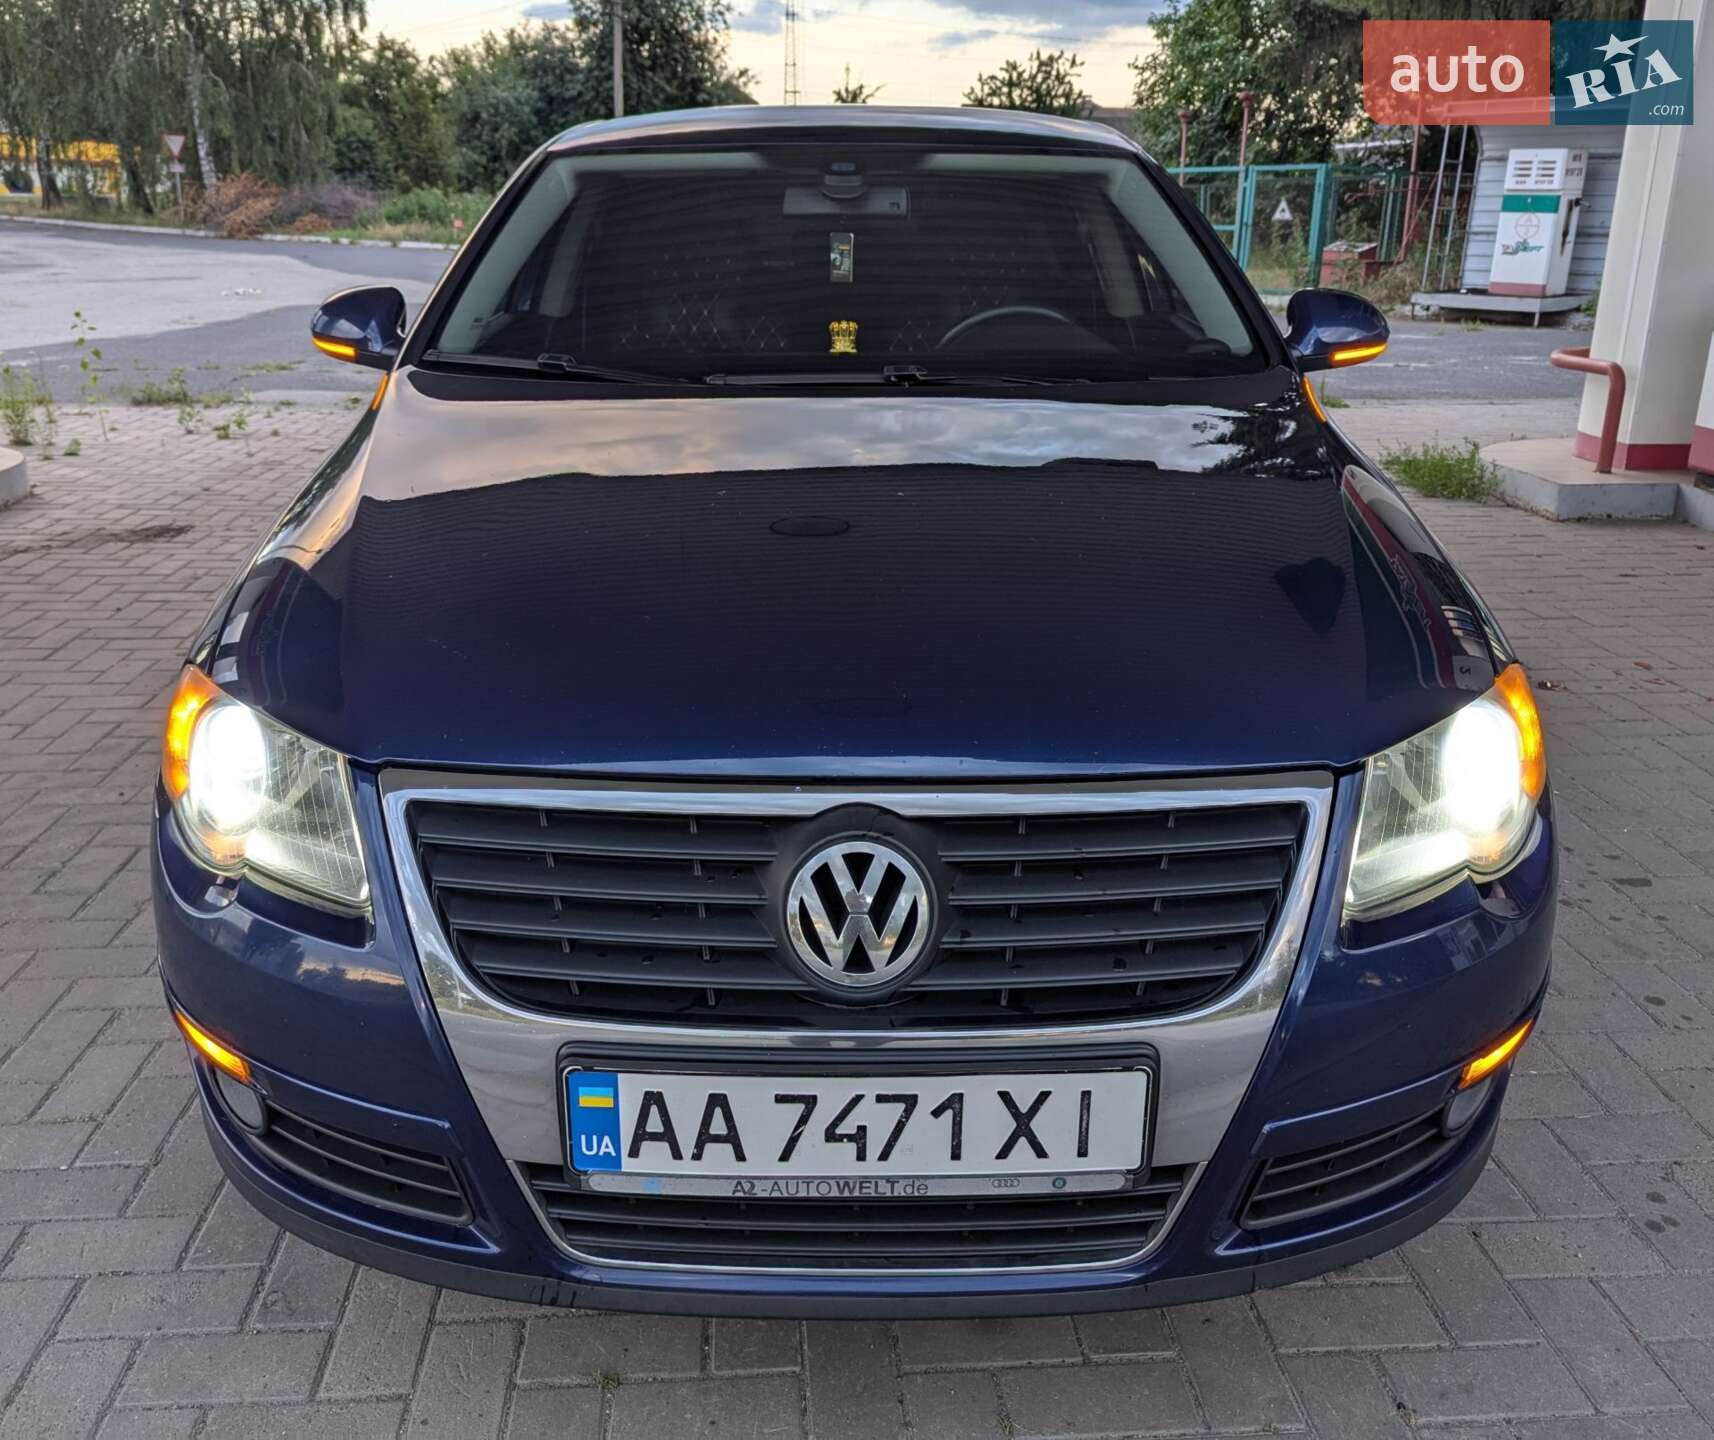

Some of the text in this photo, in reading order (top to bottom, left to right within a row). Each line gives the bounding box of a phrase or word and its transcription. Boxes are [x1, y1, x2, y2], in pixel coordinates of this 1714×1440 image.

[580, 1134, 617, 1156] UA
[627, 1090, 1093, 1162] AA 7471 XI
